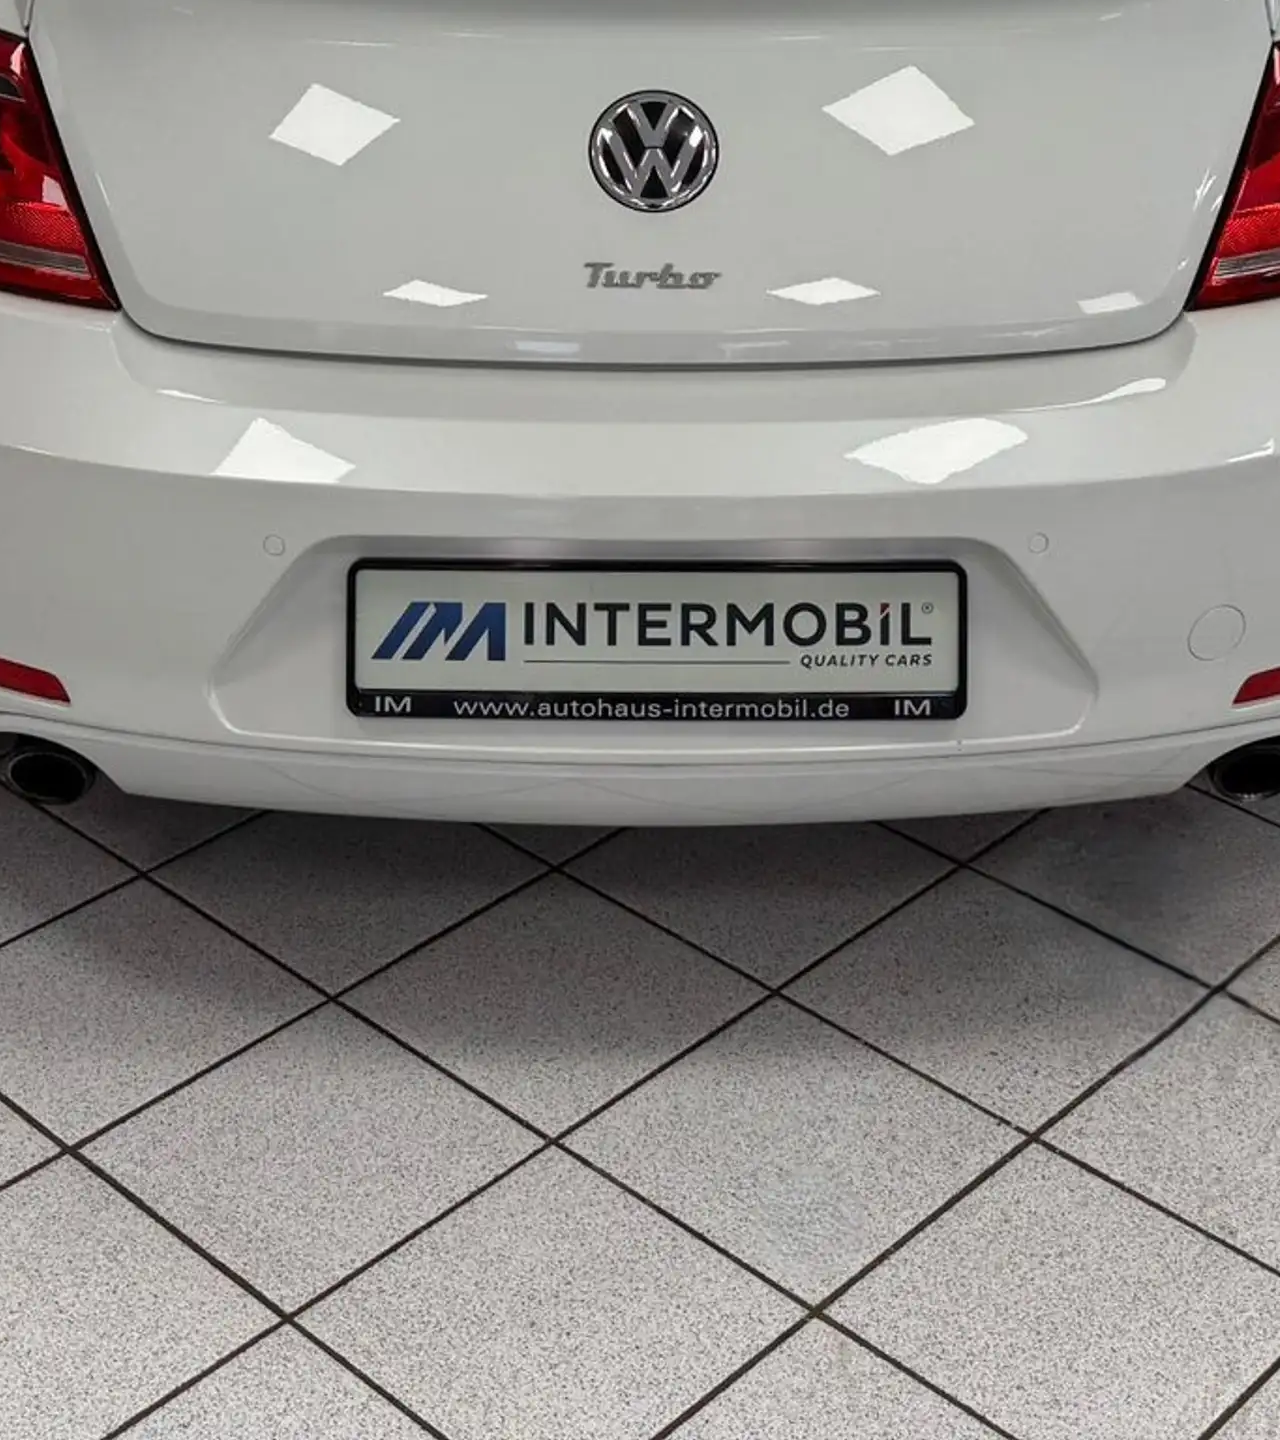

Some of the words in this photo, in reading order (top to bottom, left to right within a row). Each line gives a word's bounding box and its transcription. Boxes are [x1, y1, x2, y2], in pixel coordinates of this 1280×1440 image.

[590, 93, 718, 210] VW
[583, 261, 722, 290] Turbo
[799, 653, 880, 669] QUALITY
[885, 653, 933, 667] CARS
[374, 695, 412, 713] IM
[453, 697, 850, 718] www.autohaus-intermobil.de
[894, 698, 932, 716] IM
